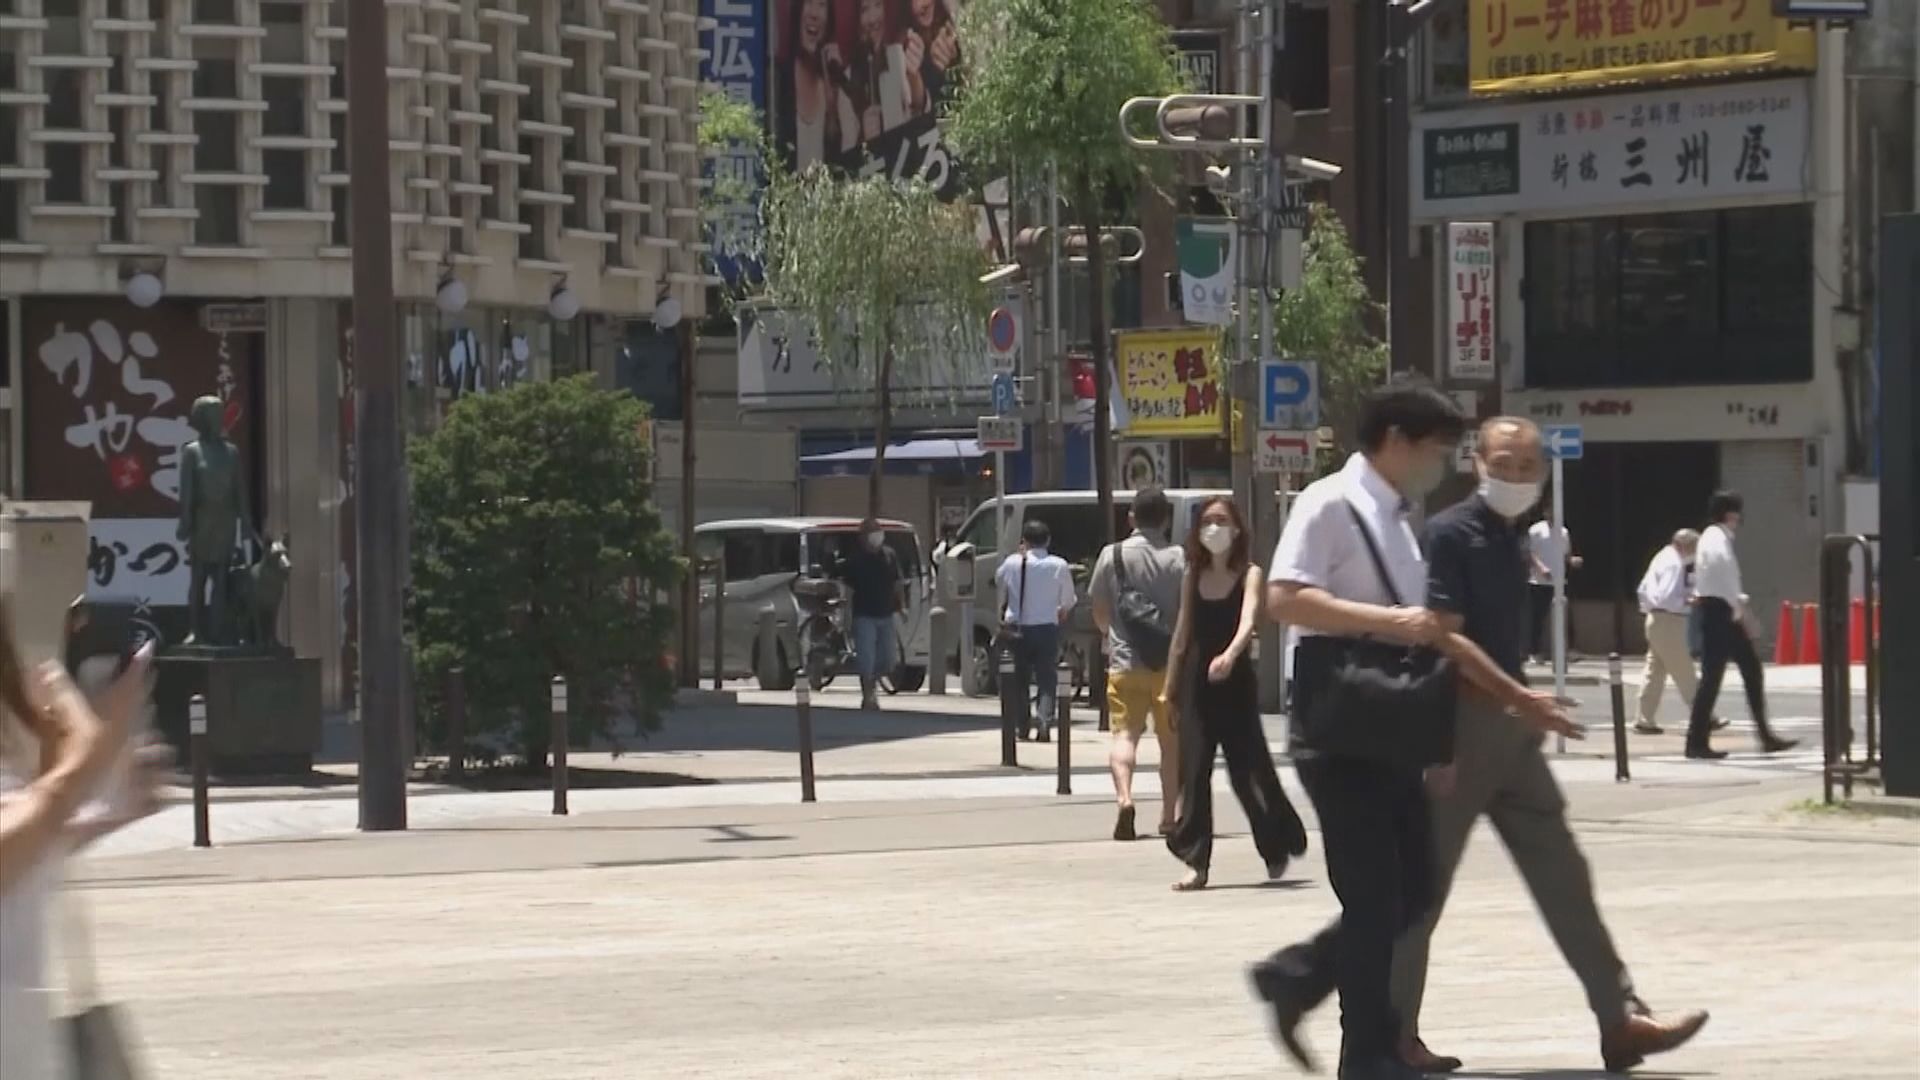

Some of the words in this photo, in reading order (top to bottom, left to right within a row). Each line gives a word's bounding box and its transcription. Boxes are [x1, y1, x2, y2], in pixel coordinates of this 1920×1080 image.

[1620, 124, 1771, 188] 三州屋
[1456, 271, 1478, 348] リーチ
[38, 319, 175, 412] から
[1265, 364, 1310, 422] P
